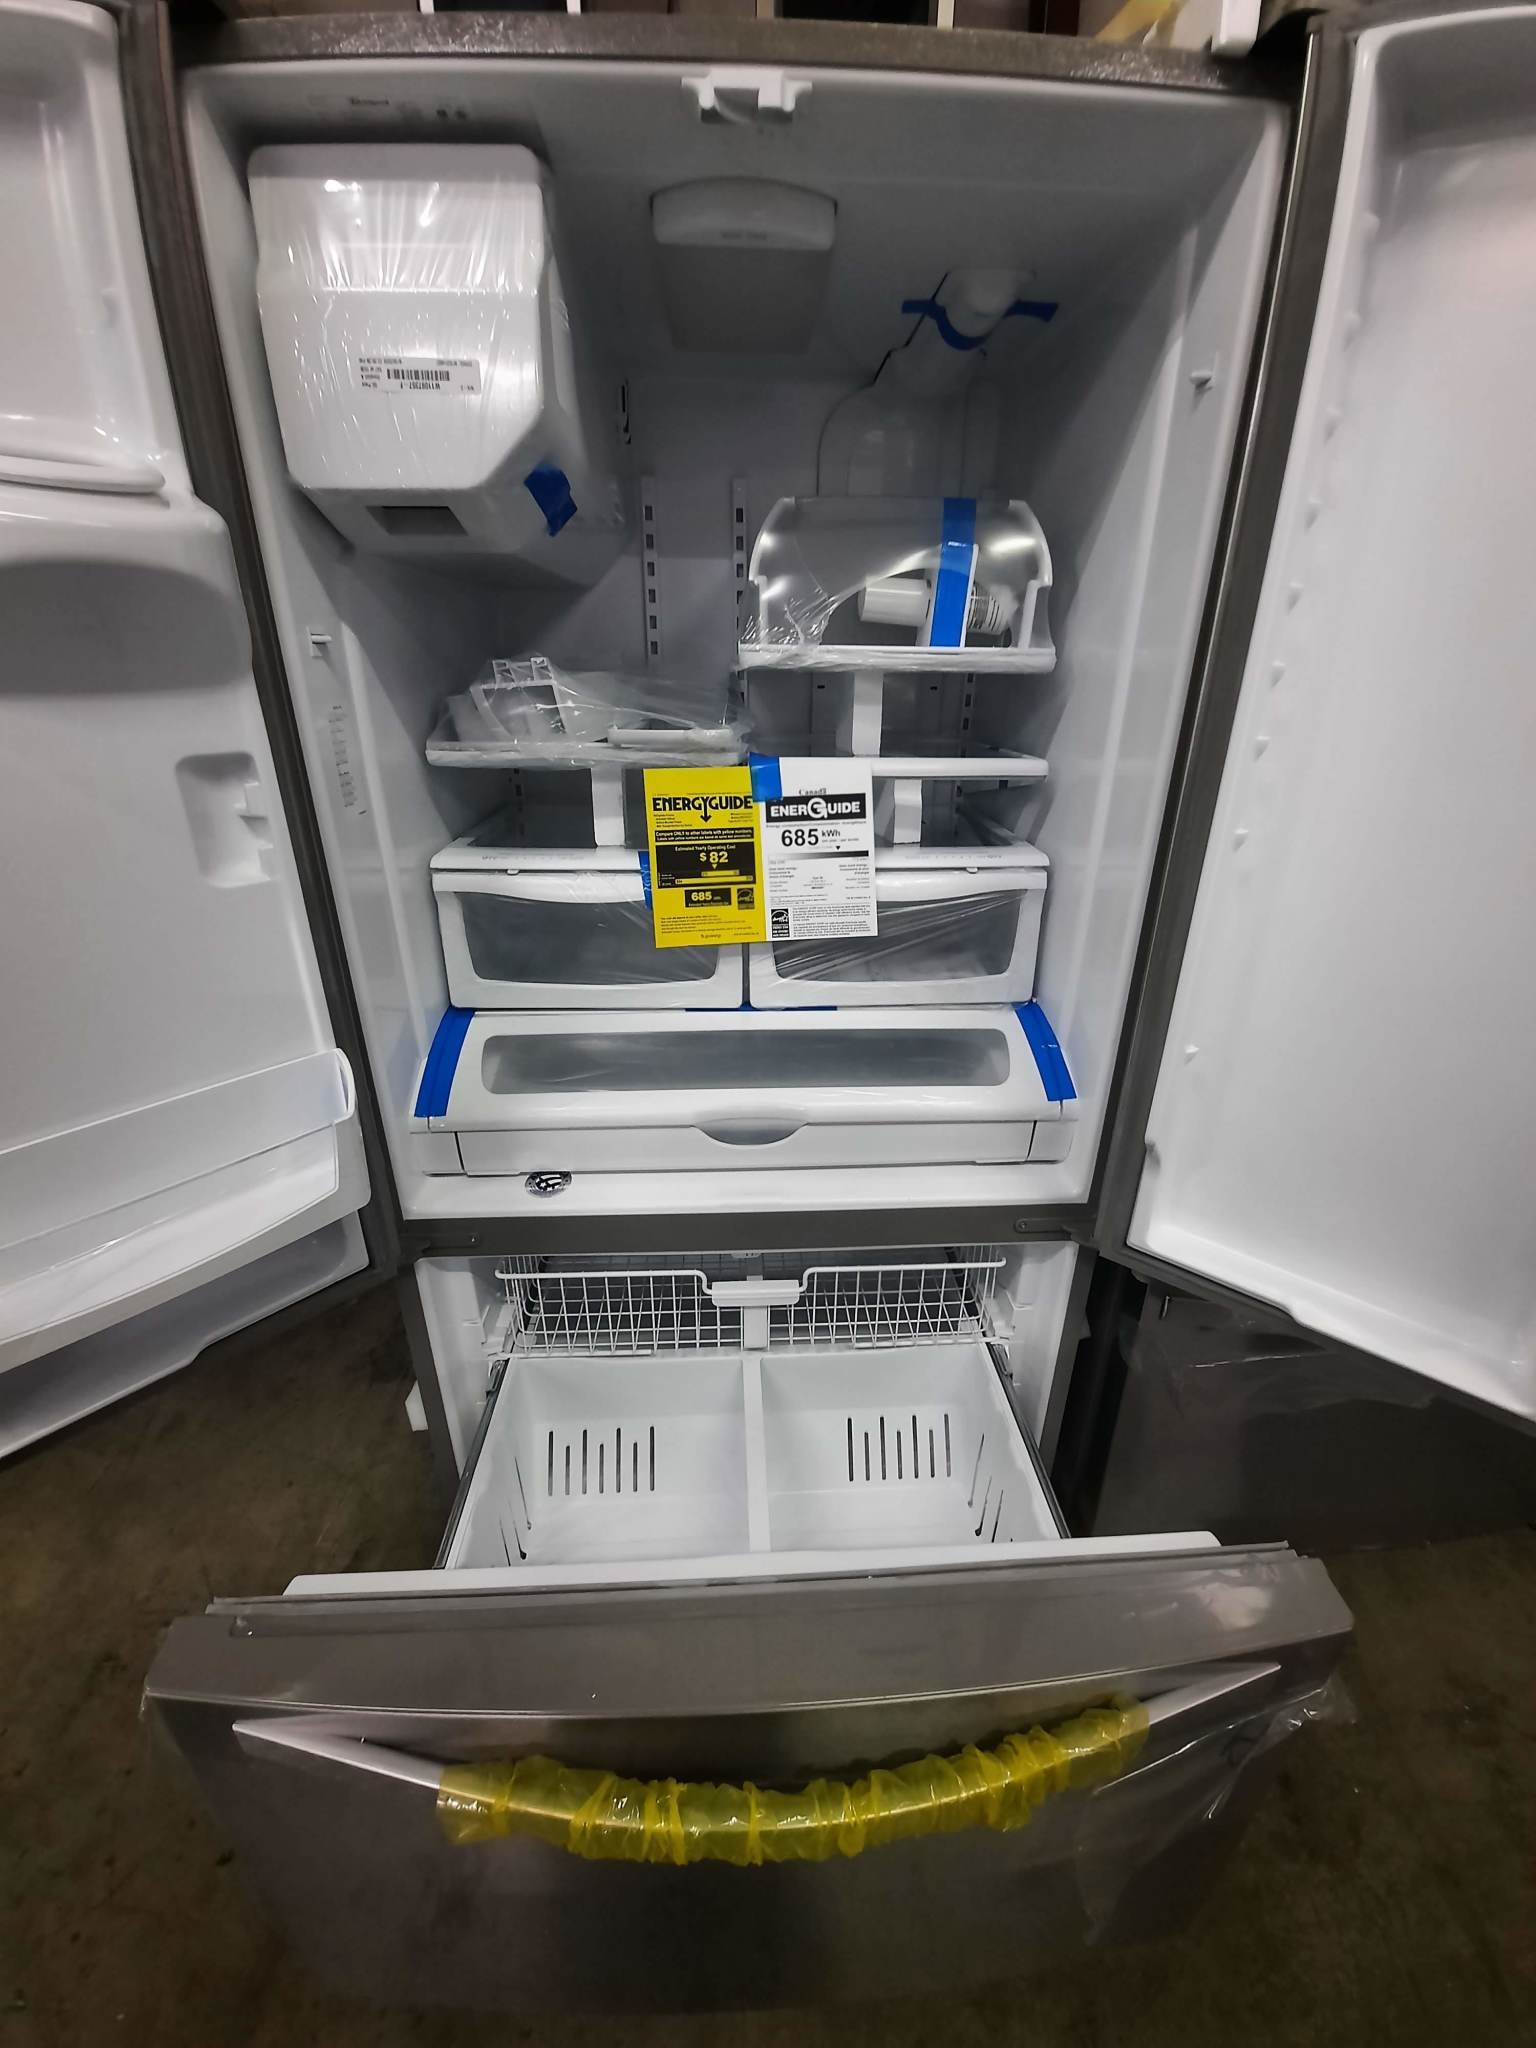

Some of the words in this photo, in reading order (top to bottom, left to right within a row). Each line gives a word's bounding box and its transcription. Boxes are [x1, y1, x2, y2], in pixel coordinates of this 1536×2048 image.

[652, 796, 753, 814] ENERGYGUIDE
[770, 797, 860, 818] ENERGUIDE
[781, 828, 819, 847] 685
[821, 829, 841, 837] kWh
[700, 852, 707, 862] $
[709, 851, 728, 863] 82
[691, 891, 712, 901] 685
